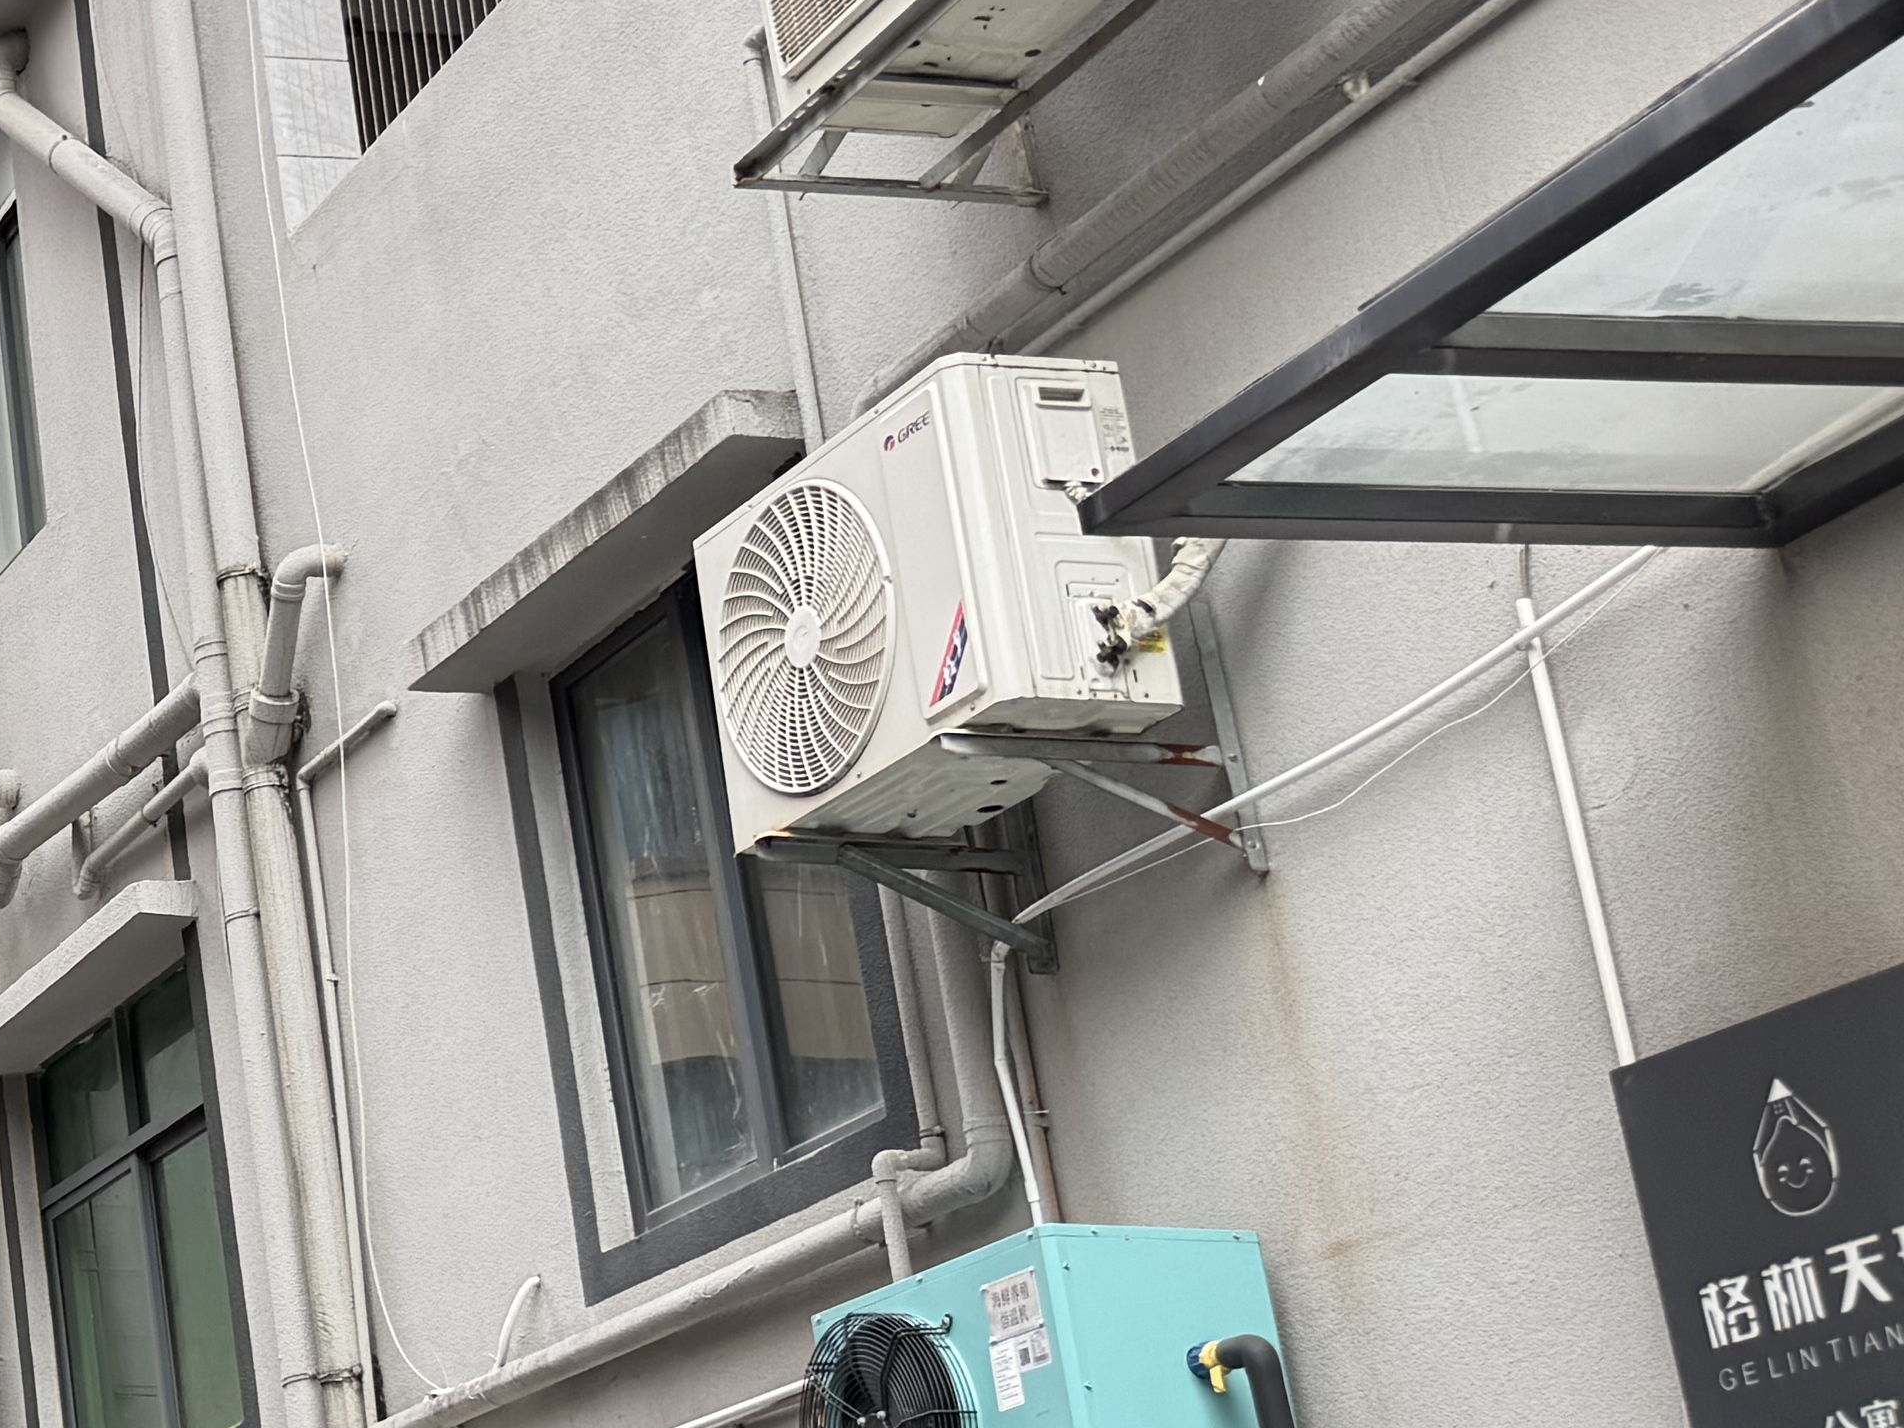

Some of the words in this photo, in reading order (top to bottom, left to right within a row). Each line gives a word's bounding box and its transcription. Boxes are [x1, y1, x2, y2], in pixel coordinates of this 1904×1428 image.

[898, 410, 930, 443] GREE
[1698, 1224, 1904, 1349] 格林天
